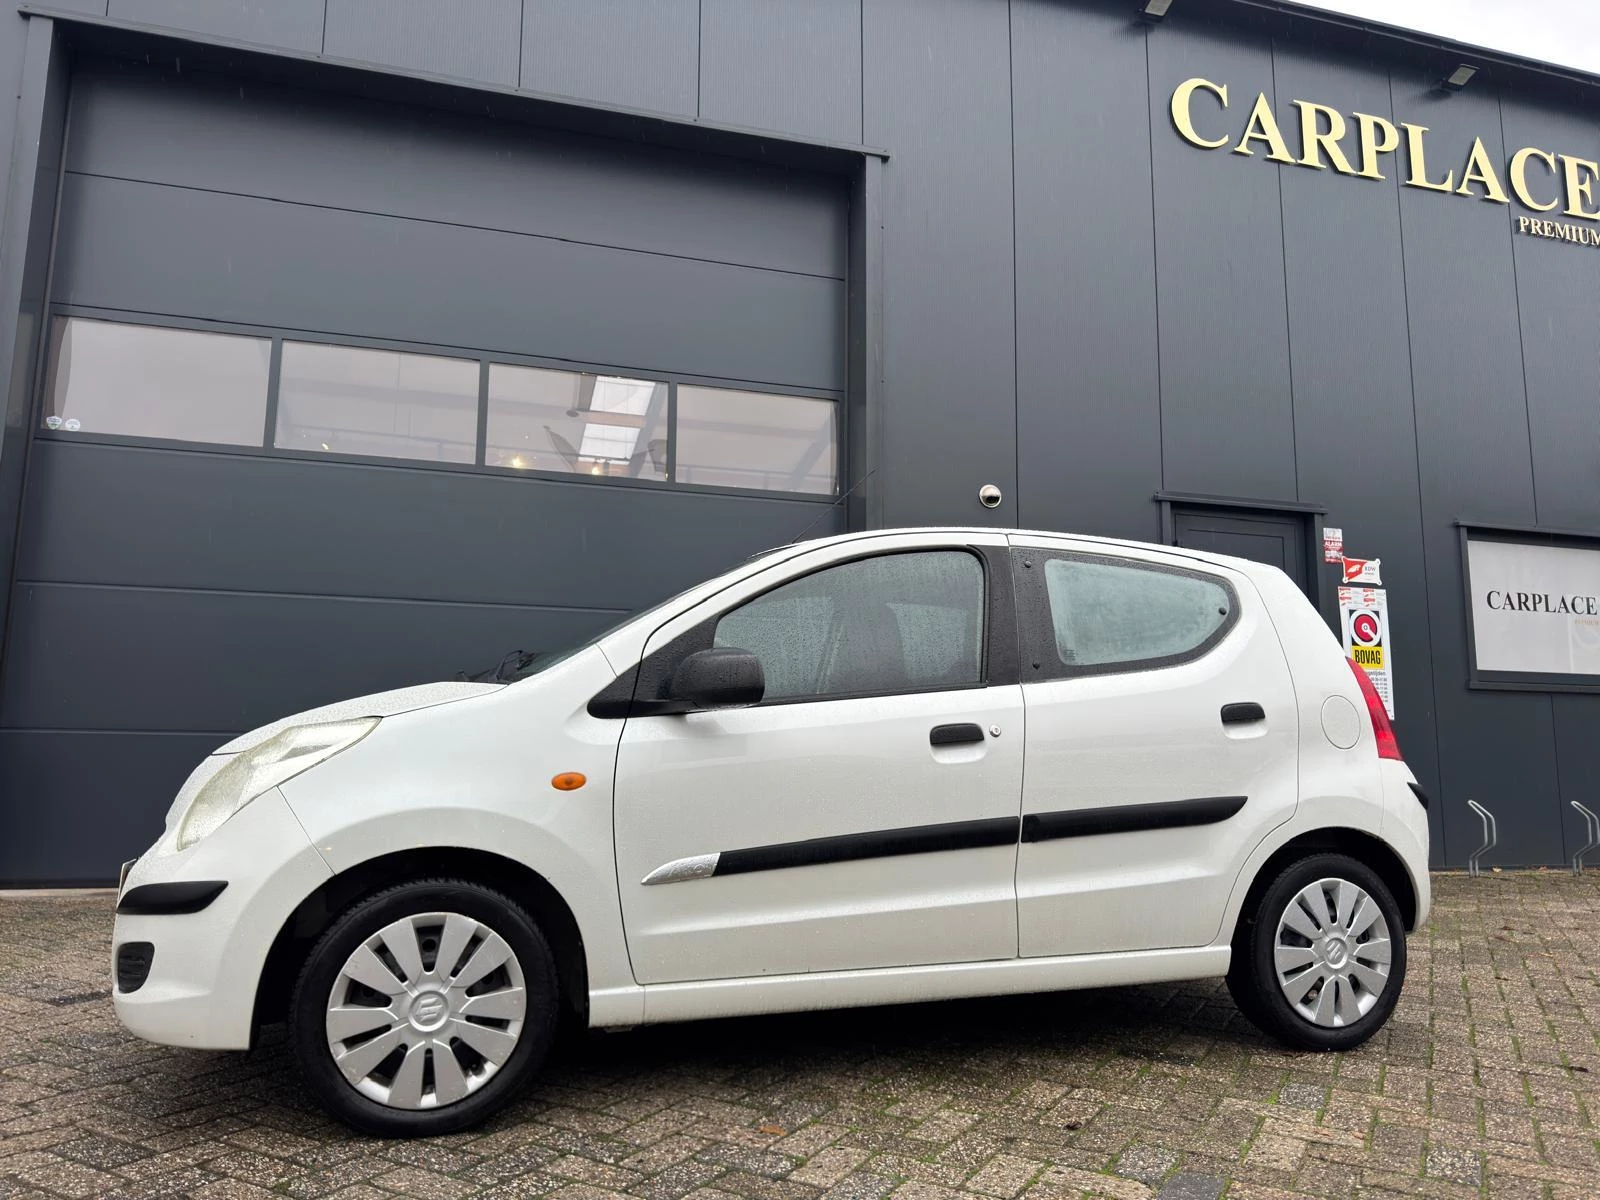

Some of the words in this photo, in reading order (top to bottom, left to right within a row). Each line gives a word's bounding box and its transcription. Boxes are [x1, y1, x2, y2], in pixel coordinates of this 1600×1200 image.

[1171, 77, 1600, 220] CARPLACE
[1518, 215, 1600, 246] PREMIUM
[1486, 590, 1598, 616] CARPLACE
[1354, 649, 1381, 665] BOVAG
